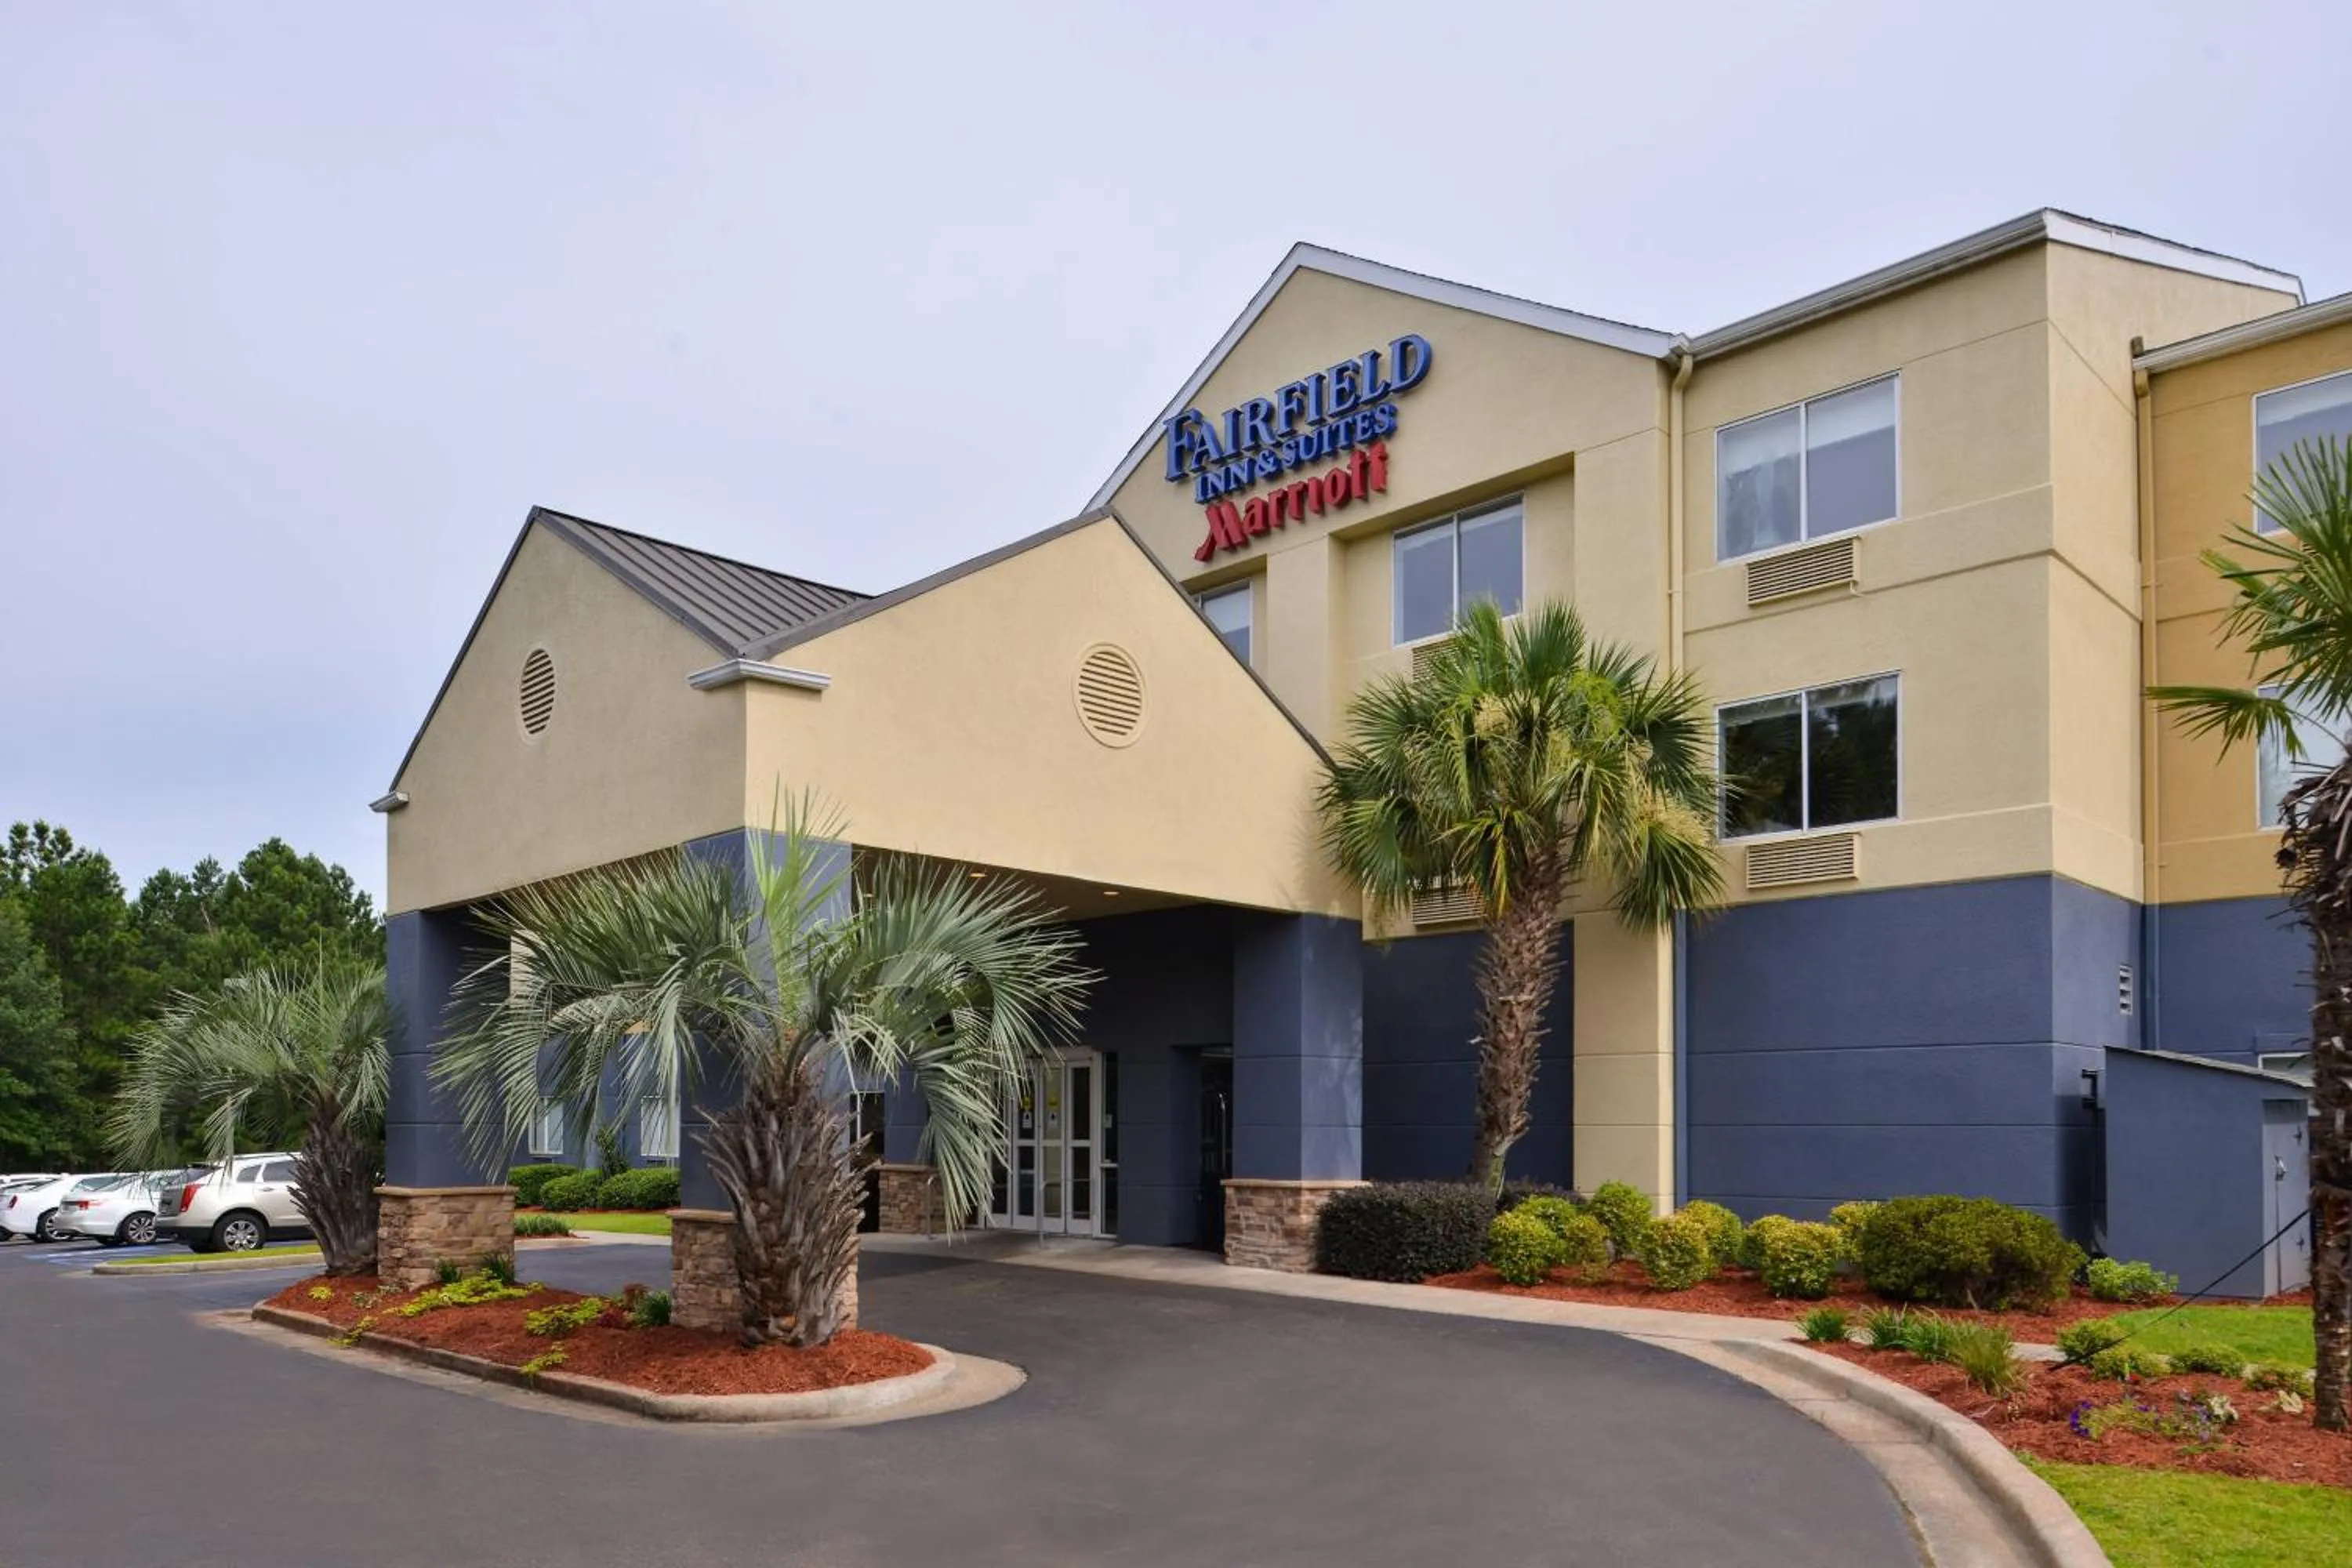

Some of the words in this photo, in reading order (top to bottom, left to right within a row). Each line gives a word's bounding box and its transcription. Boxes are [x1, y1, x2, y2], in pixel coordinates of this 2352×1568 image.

[1163, 333, 1432, 482] FAIRFIELD
[1195, 456, 1255, 504] INN
[1254, 448, 1282, 478] &
[1281, 402, 1398, 472] SUITES
[1194, 441, 1388, 562] Marriott
